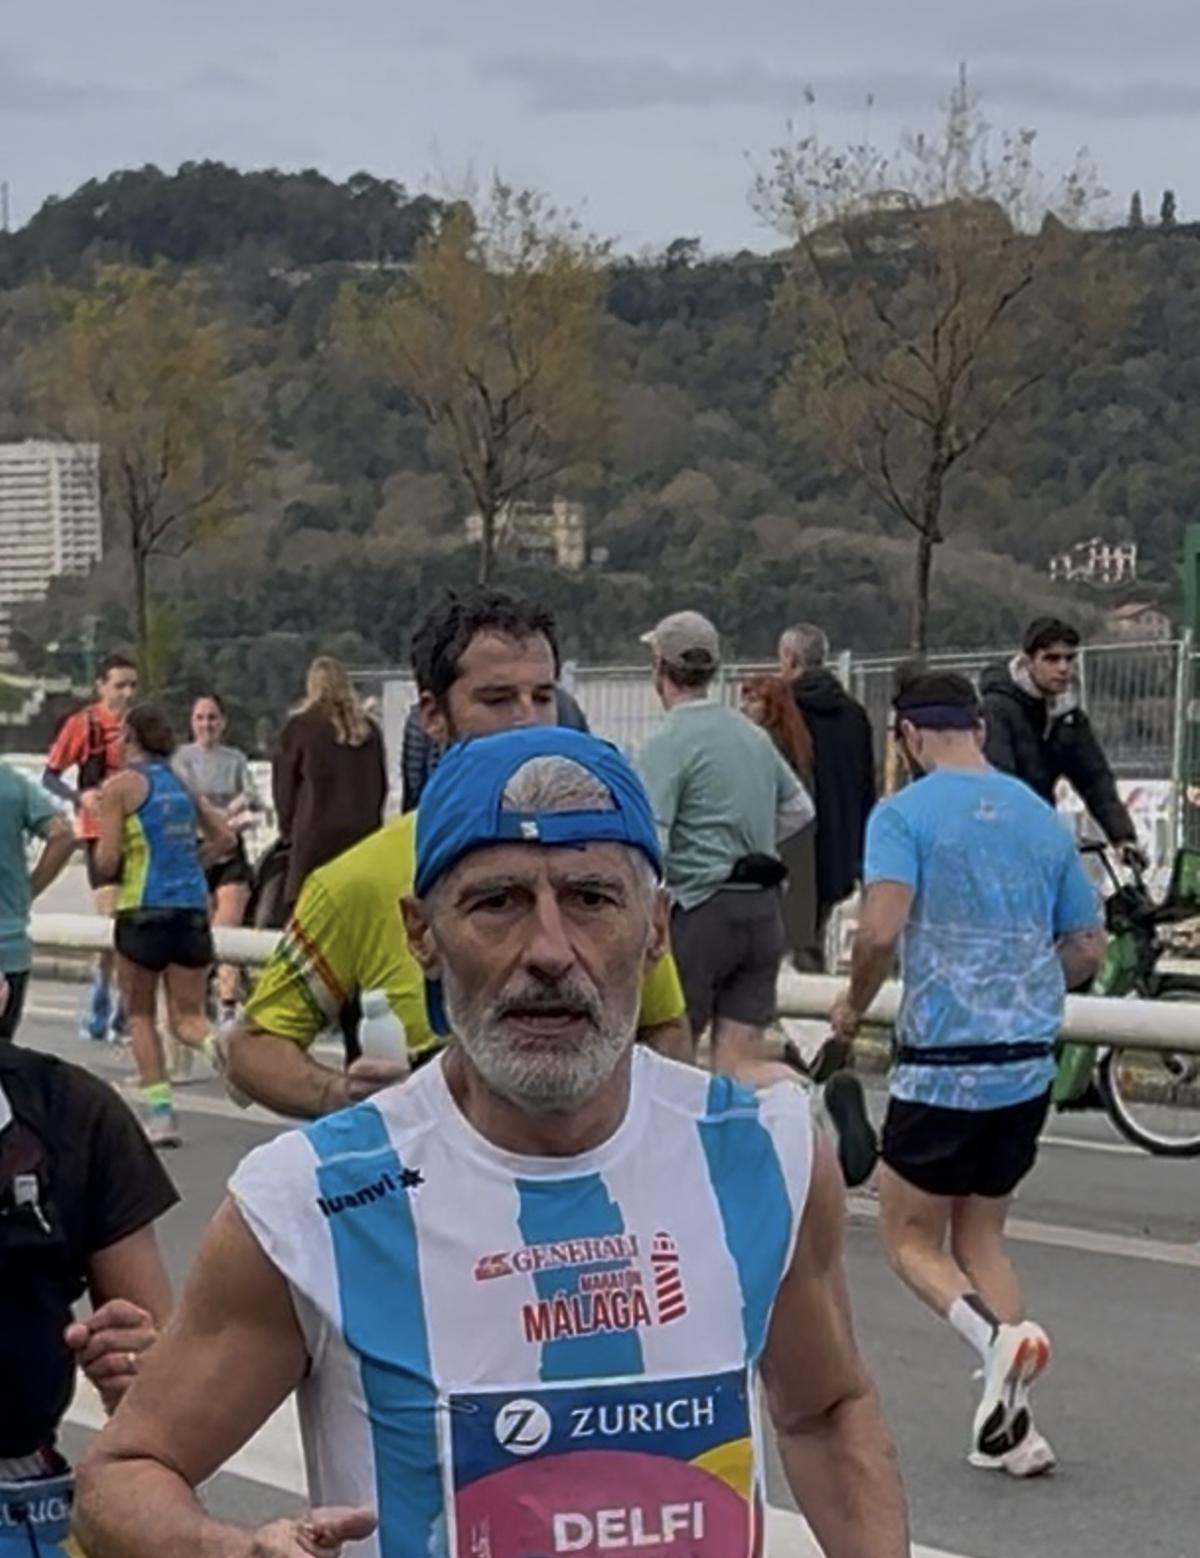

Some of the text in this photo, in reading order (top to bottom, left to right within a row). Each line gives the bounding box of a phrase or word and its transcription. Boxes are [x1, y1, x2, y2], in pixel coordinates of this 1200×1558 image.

[512, 1234, 639, 1273] GENERALI
[522, 1289, 652, 1343] MÁLAGA
[570, 1395, 716, 1438] ZURICH
[553, 1501, 704, 1553] DELFI
